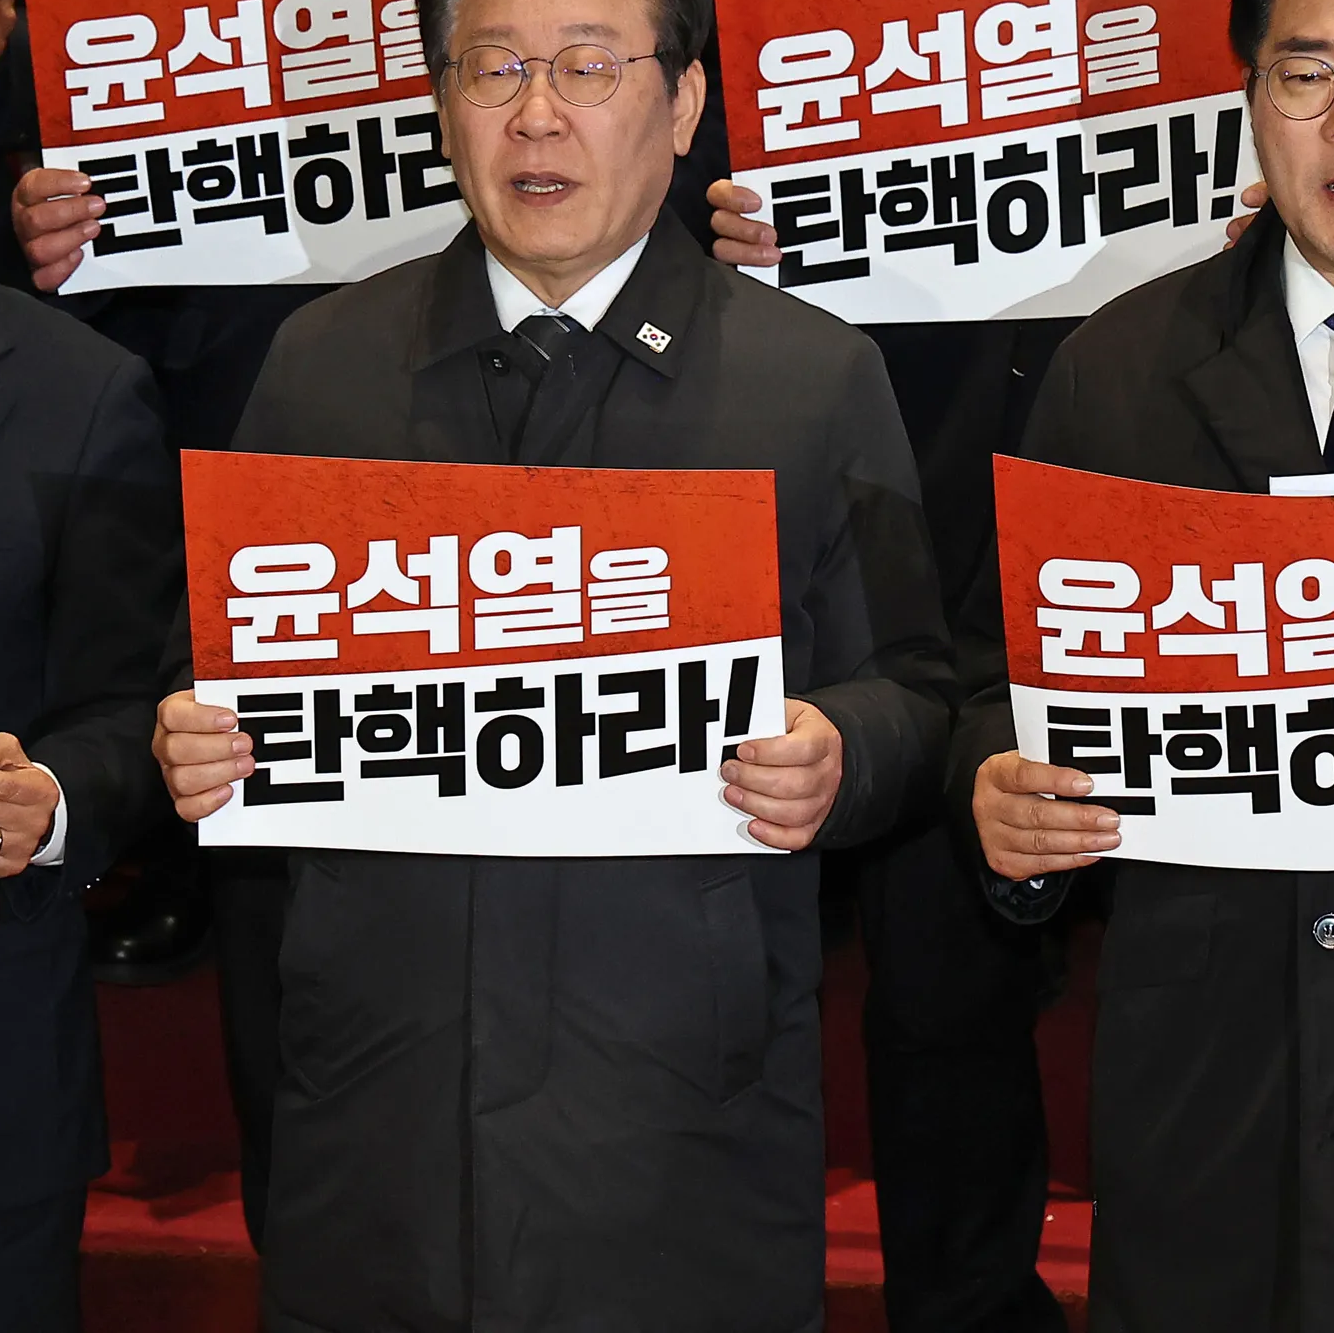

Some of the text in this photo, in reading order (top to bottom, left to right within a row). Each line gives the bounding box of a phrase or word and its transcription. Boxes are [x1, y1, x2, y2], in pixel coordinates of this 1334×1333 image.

[773, 107, 1243, 287] 탄핵하라!
[226, 526, 671, 663] 윤석열을
[237, 656, 759, 806] 탄핵하라!
